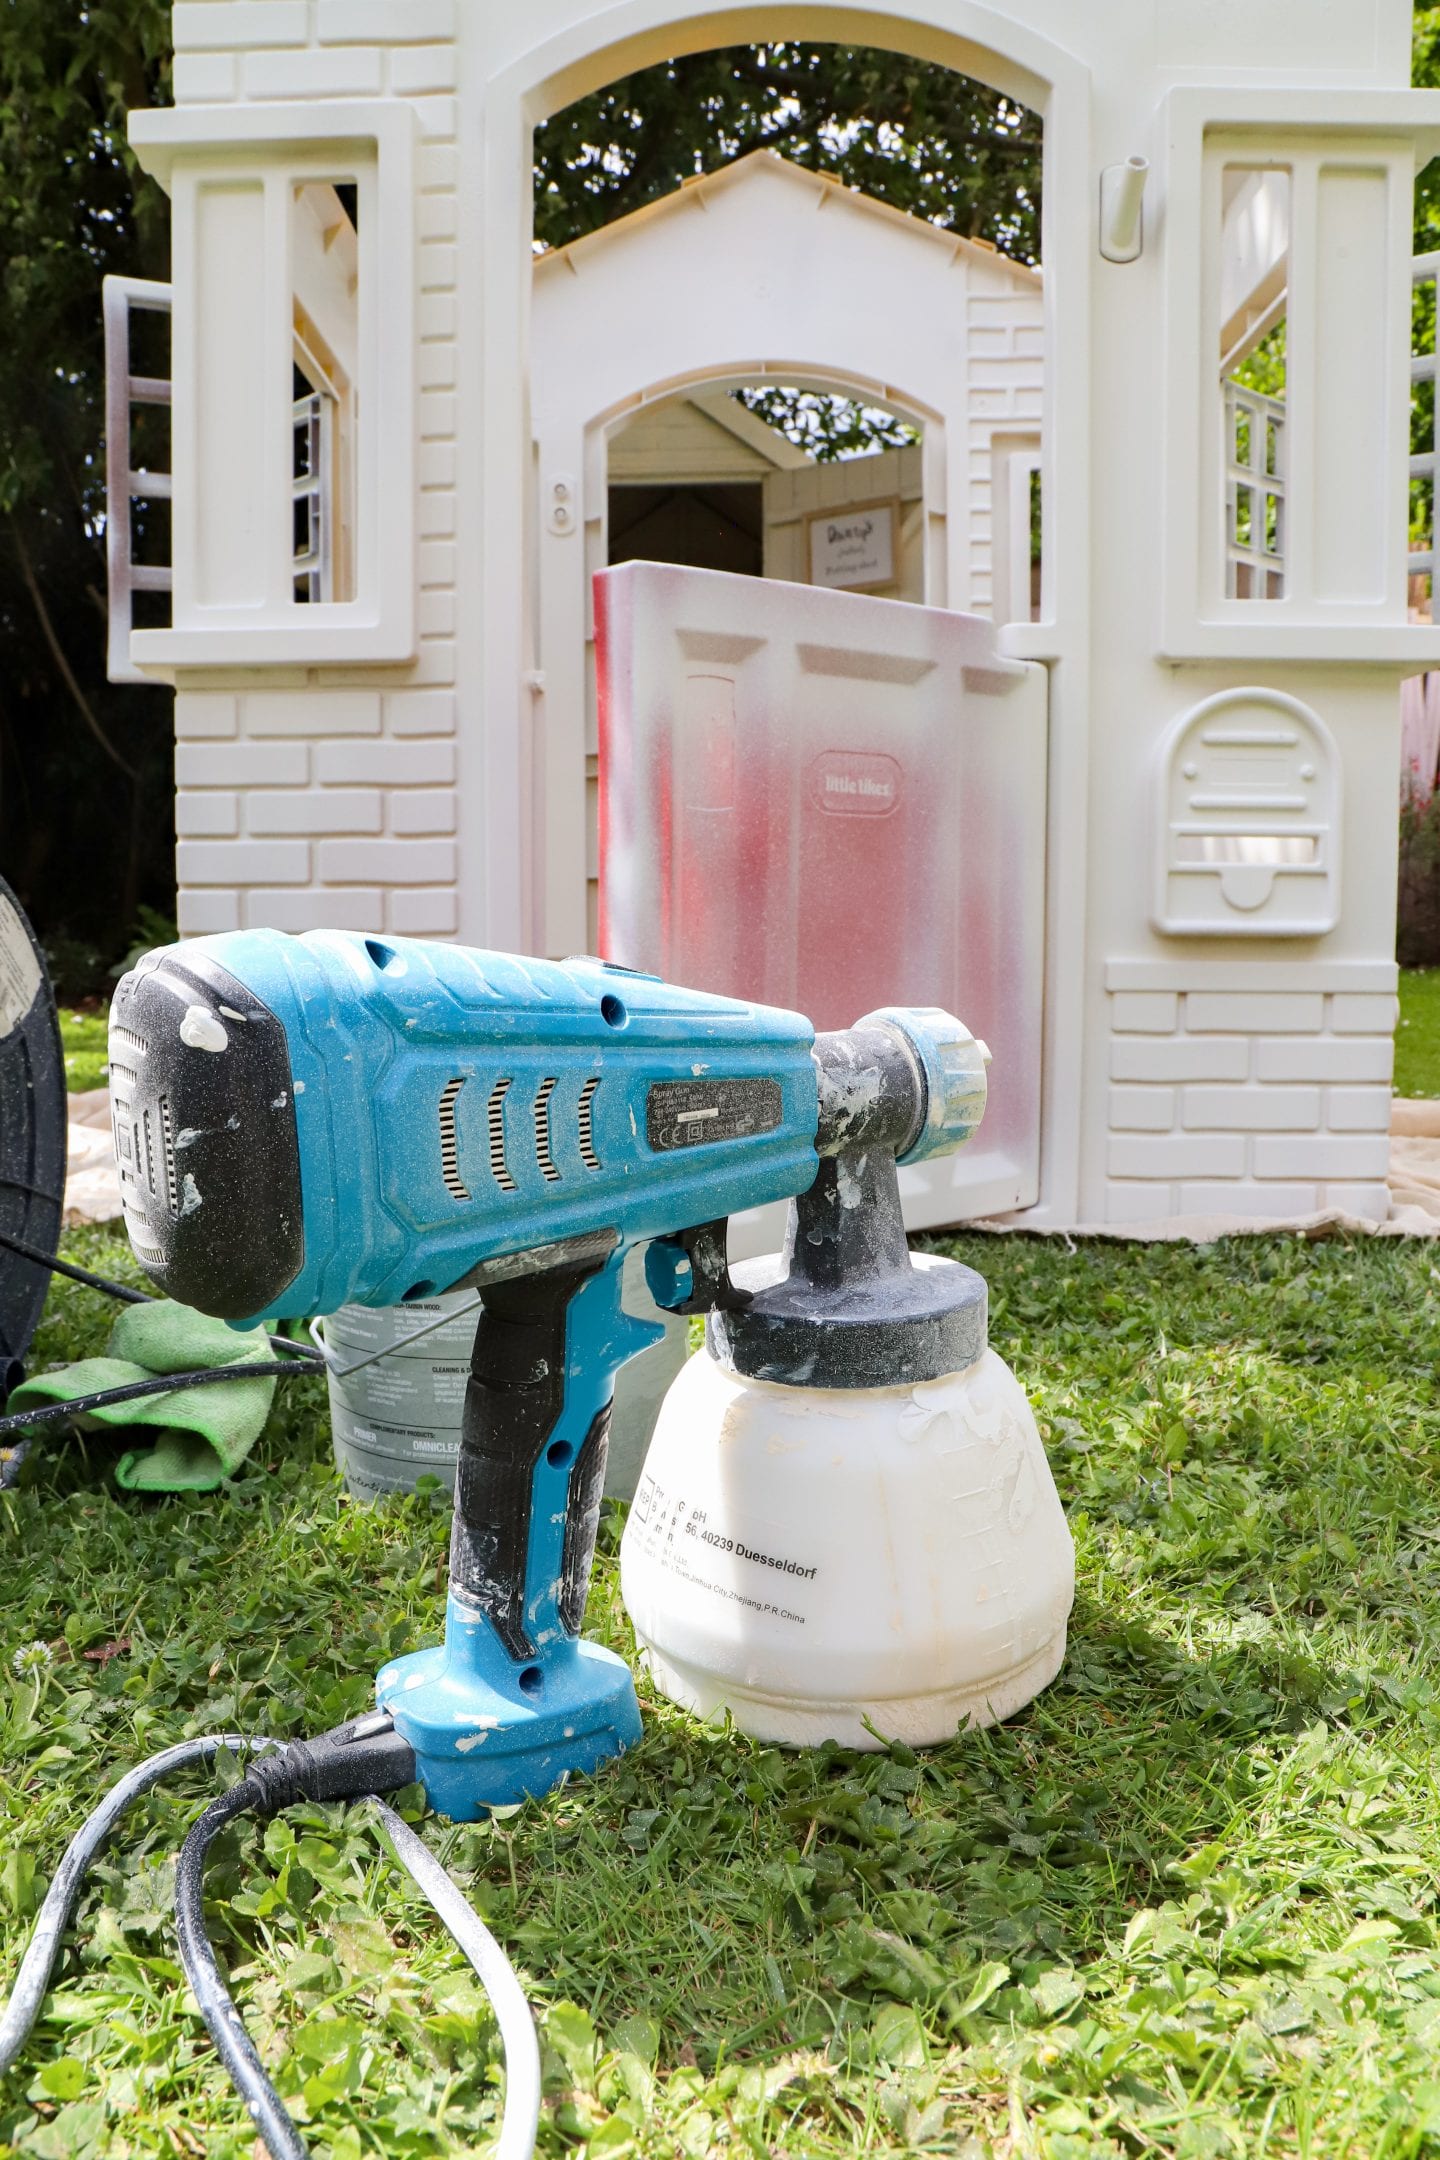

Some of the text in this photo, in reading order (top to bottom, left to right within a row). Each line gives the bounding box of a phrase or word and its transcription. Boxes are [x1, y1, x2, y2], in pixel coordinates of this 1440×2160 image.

[675, 1087, 689, 1096] Gun
[701, 1530, 734, 1553] 40239
[735, 1543, 817, 1580] Duesseldorf
